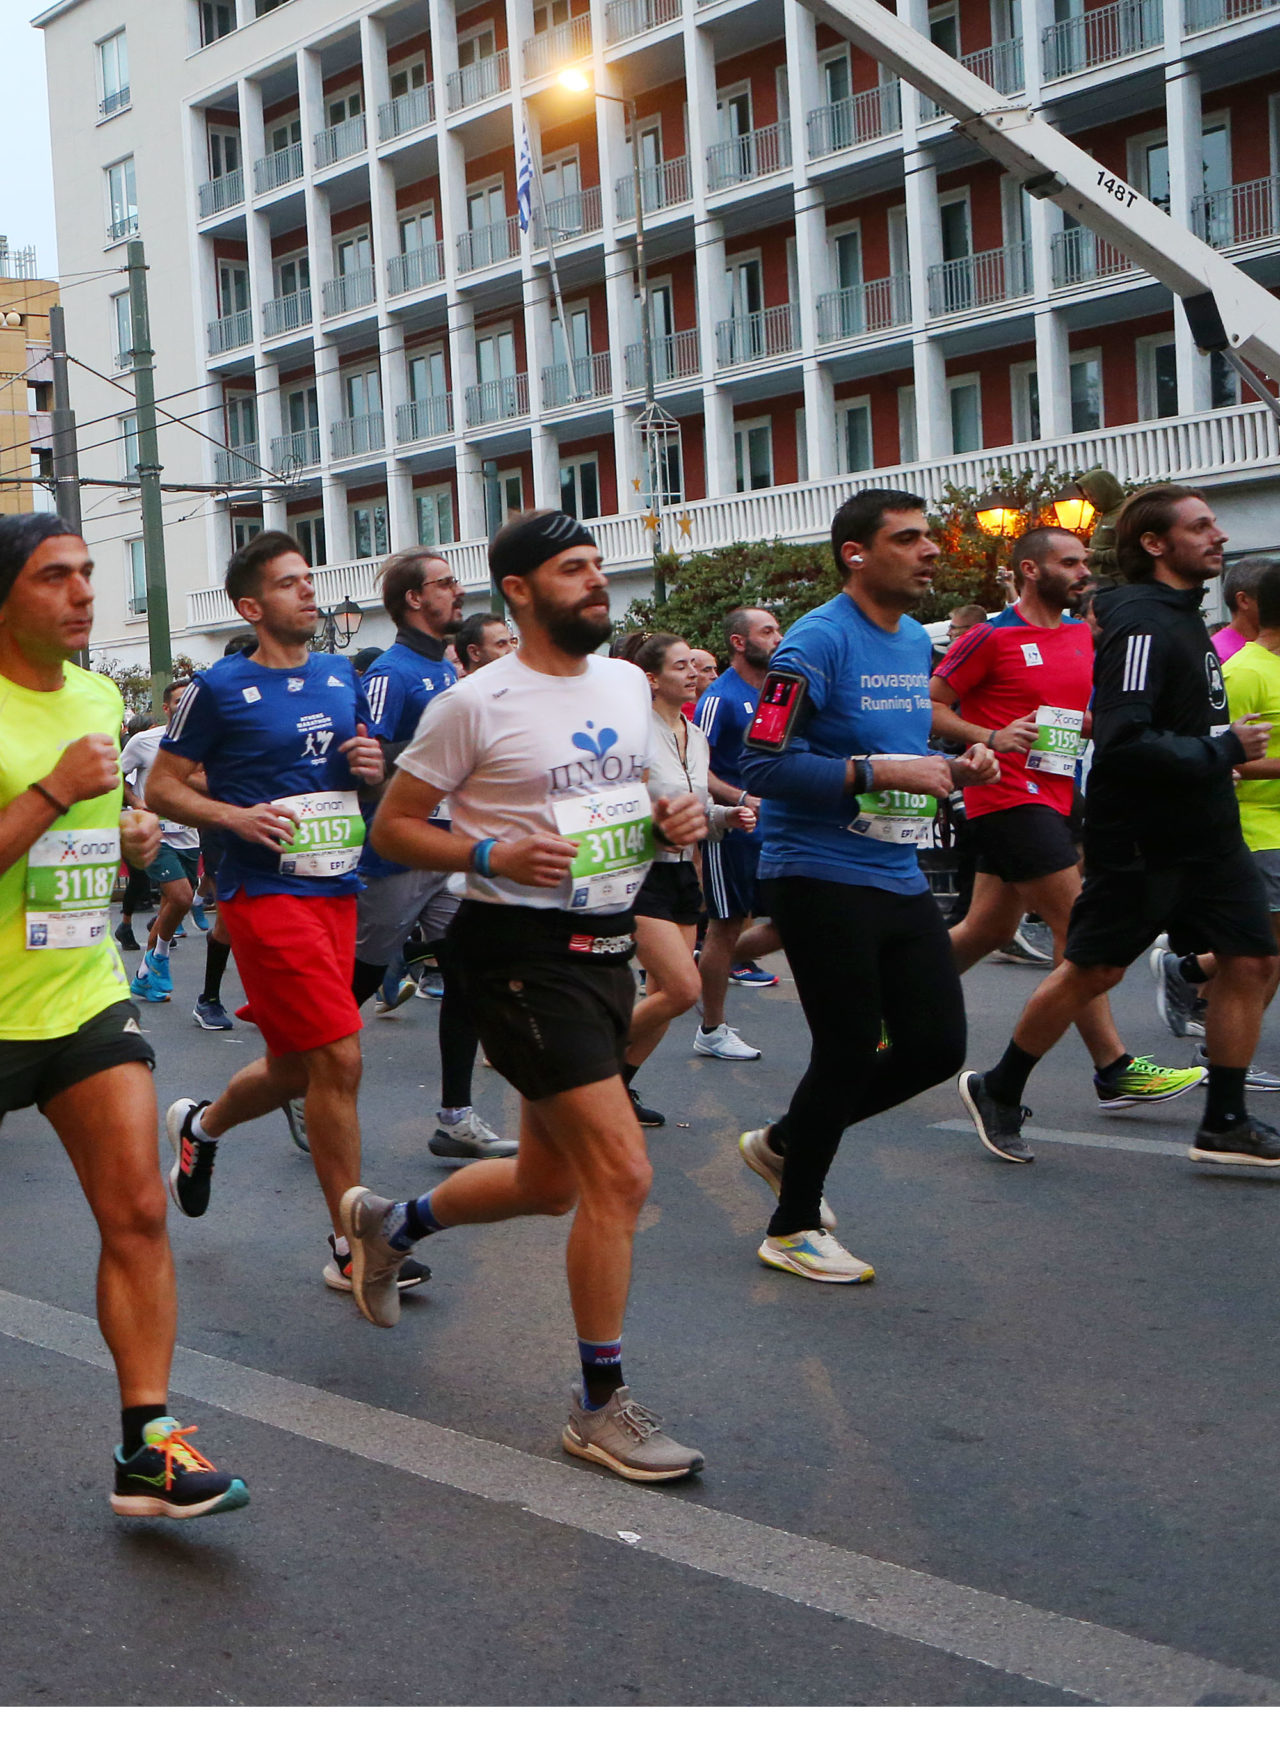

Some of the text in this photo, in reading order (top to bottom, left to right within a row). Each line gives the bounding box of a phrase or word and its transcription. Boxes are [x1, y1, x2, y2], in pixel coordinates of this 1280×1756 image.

[1097, 171, 1138, 208] 148T
[861, 673, 929, 691] novasports
[861, 695, 932, 712] Running Tea
[299, 819, 351, 844] 31157
[586, 823, 645, 863] 31146
[54, 866, 117, 901] 31187
